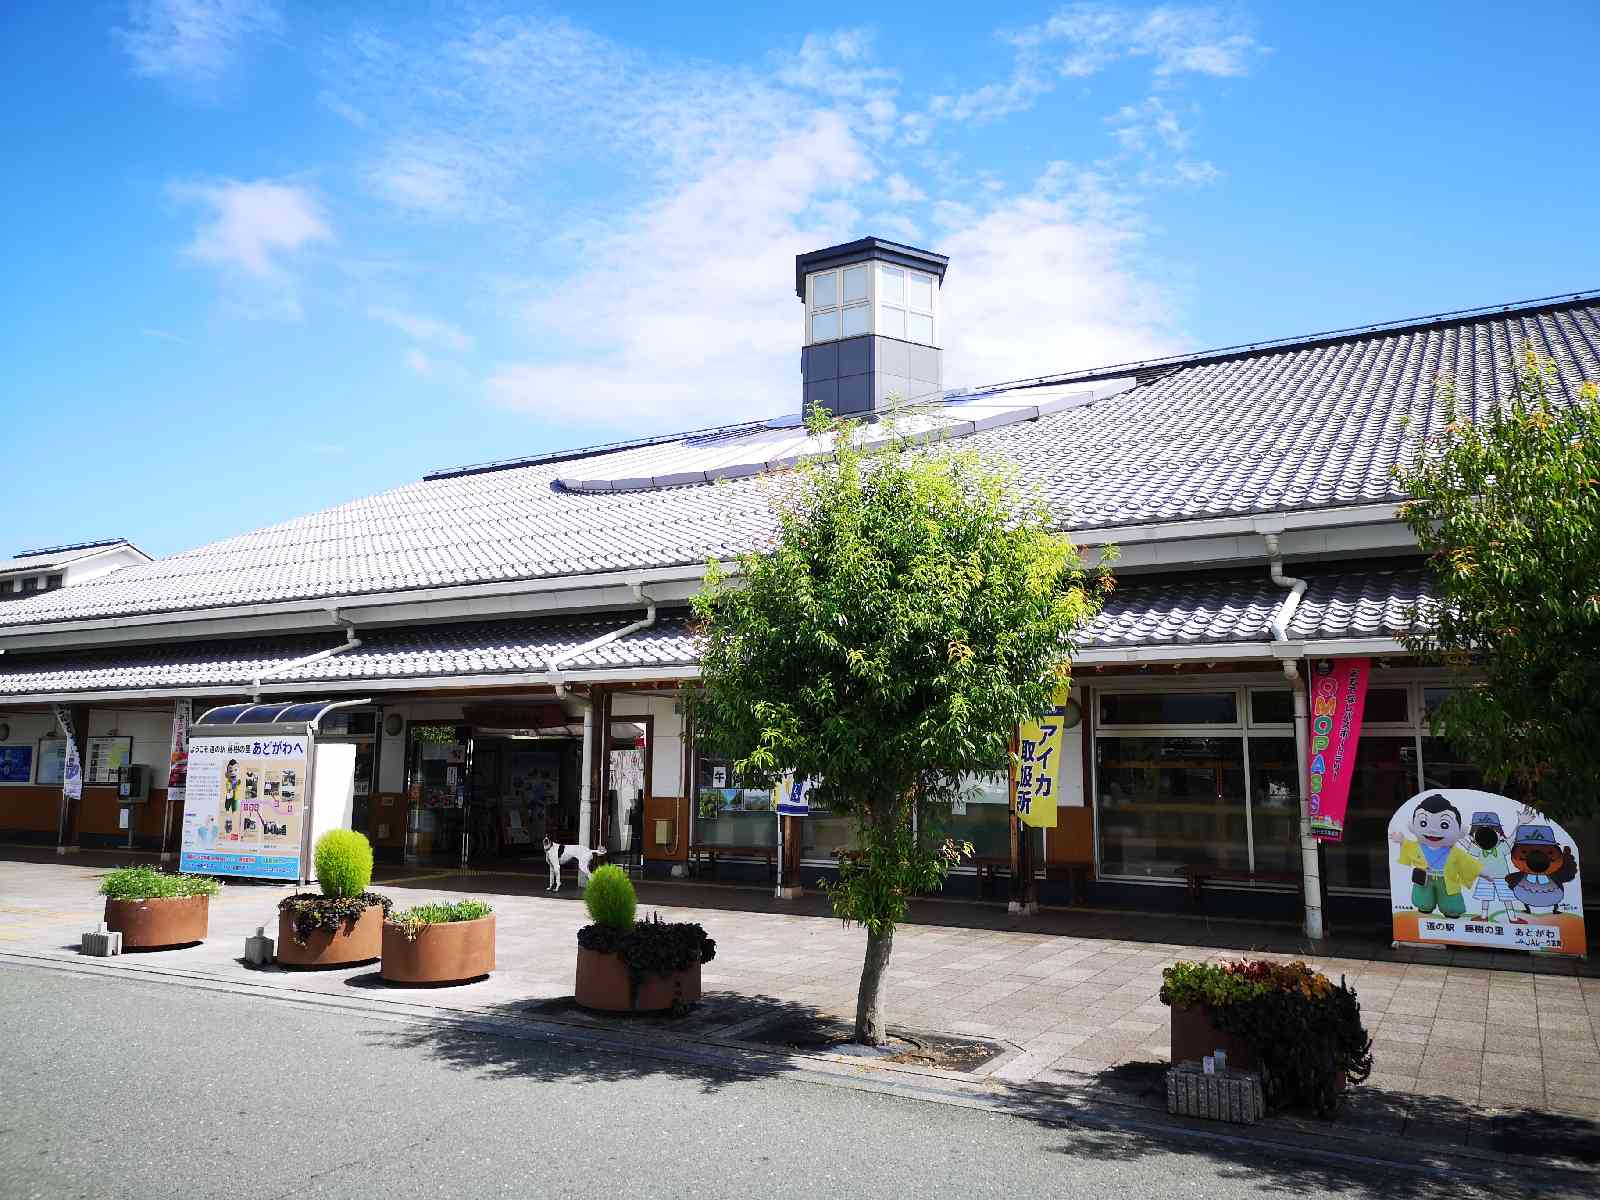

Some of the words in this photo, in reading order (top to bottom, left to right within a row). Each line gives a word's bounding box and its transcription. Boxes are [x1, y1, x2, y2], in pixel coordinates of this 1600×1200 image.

[190, 745, 208, 754] ようこそ
[252, 740, 304, 755] あどがわへ
[1311, 677, 1338, 815] OMOPASS
[1016, 740, 1036, 815] 取扱所
[1426, 921, 1456, 932] 道の駅
